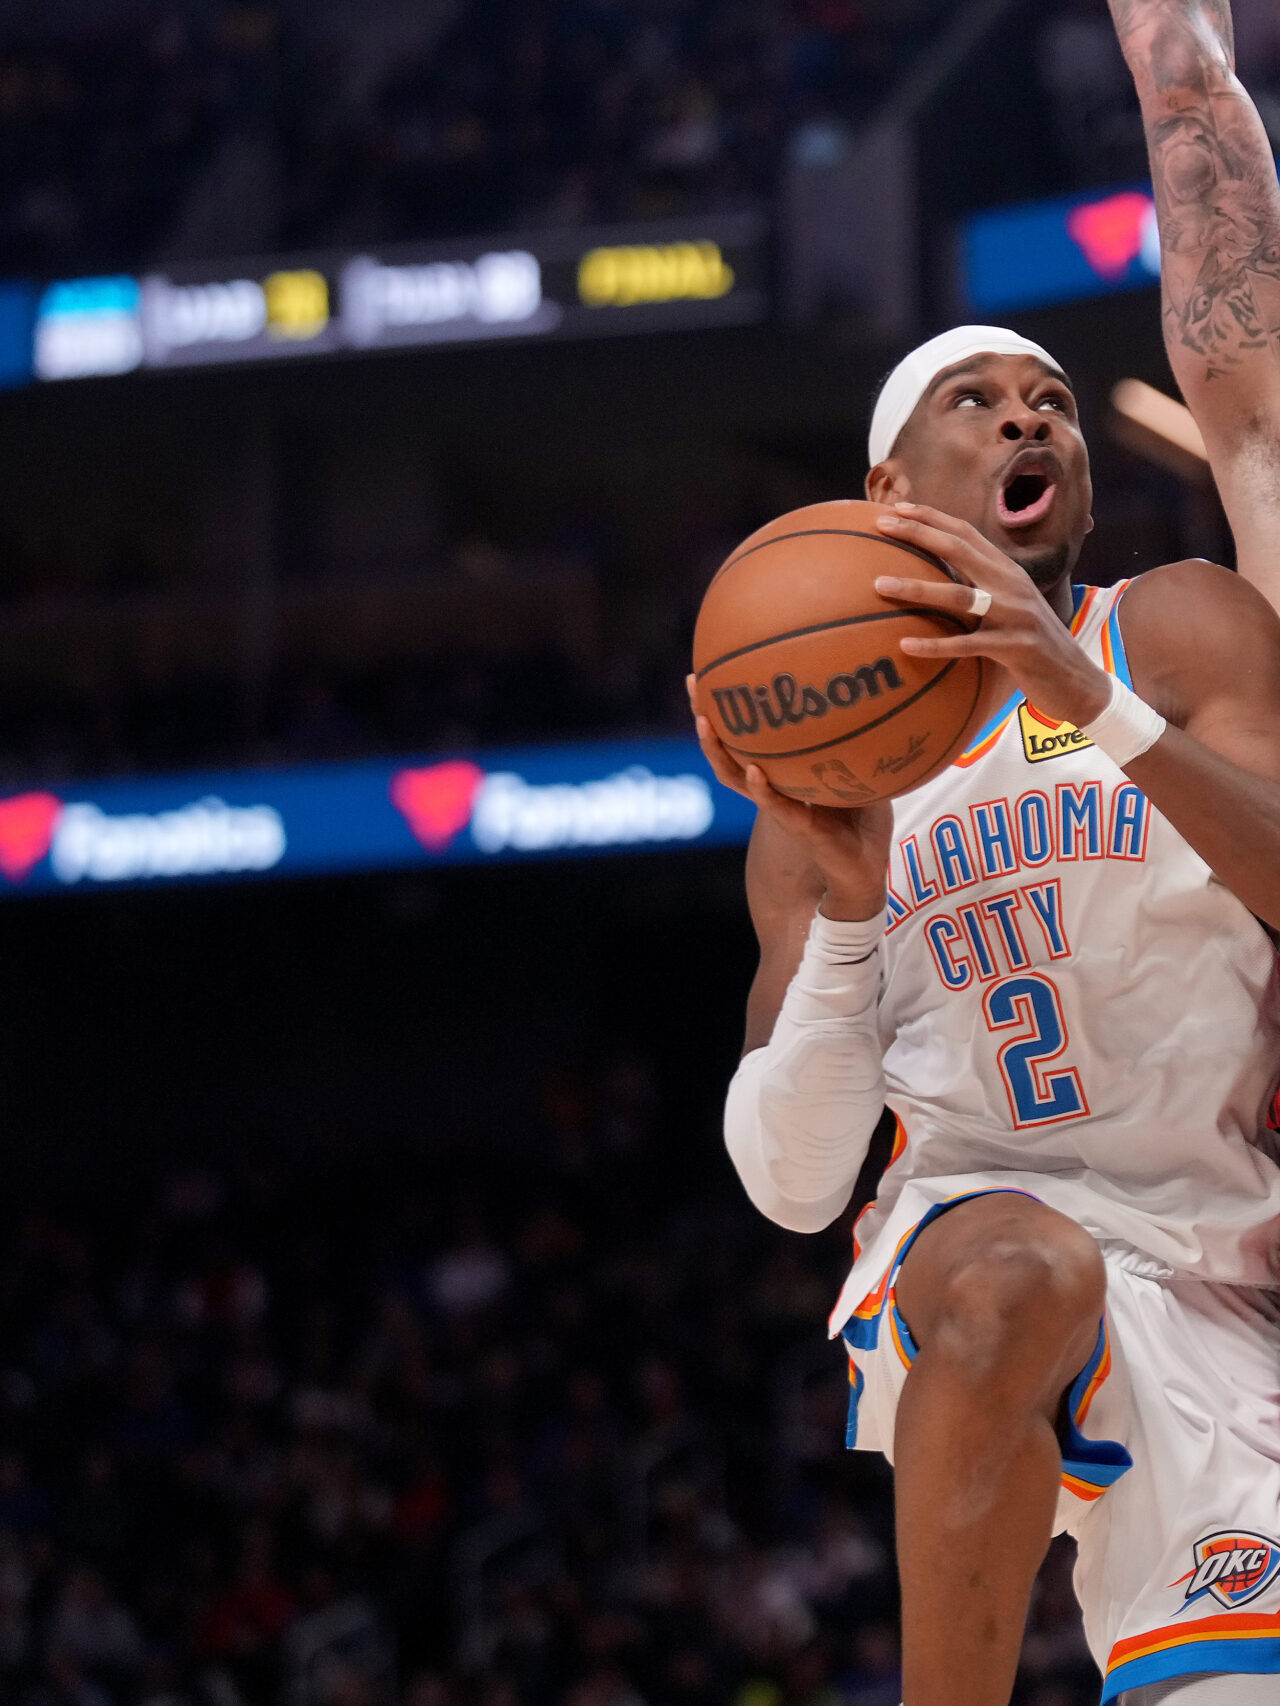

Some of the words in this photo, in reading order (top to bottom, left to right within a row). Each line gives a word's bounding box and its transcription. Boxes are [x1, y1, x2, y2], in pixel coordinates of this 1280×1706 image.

[712, 655, 904, 738] Wilson
[1028, 729, 1090, 755] Love
[885, 780, 1152, 936] LAHOMA
[923, 877, 1072, 992] CITY
[981, 971, 1091, 1131] 2
[1186, 1549, 1268, 1598] OKC
